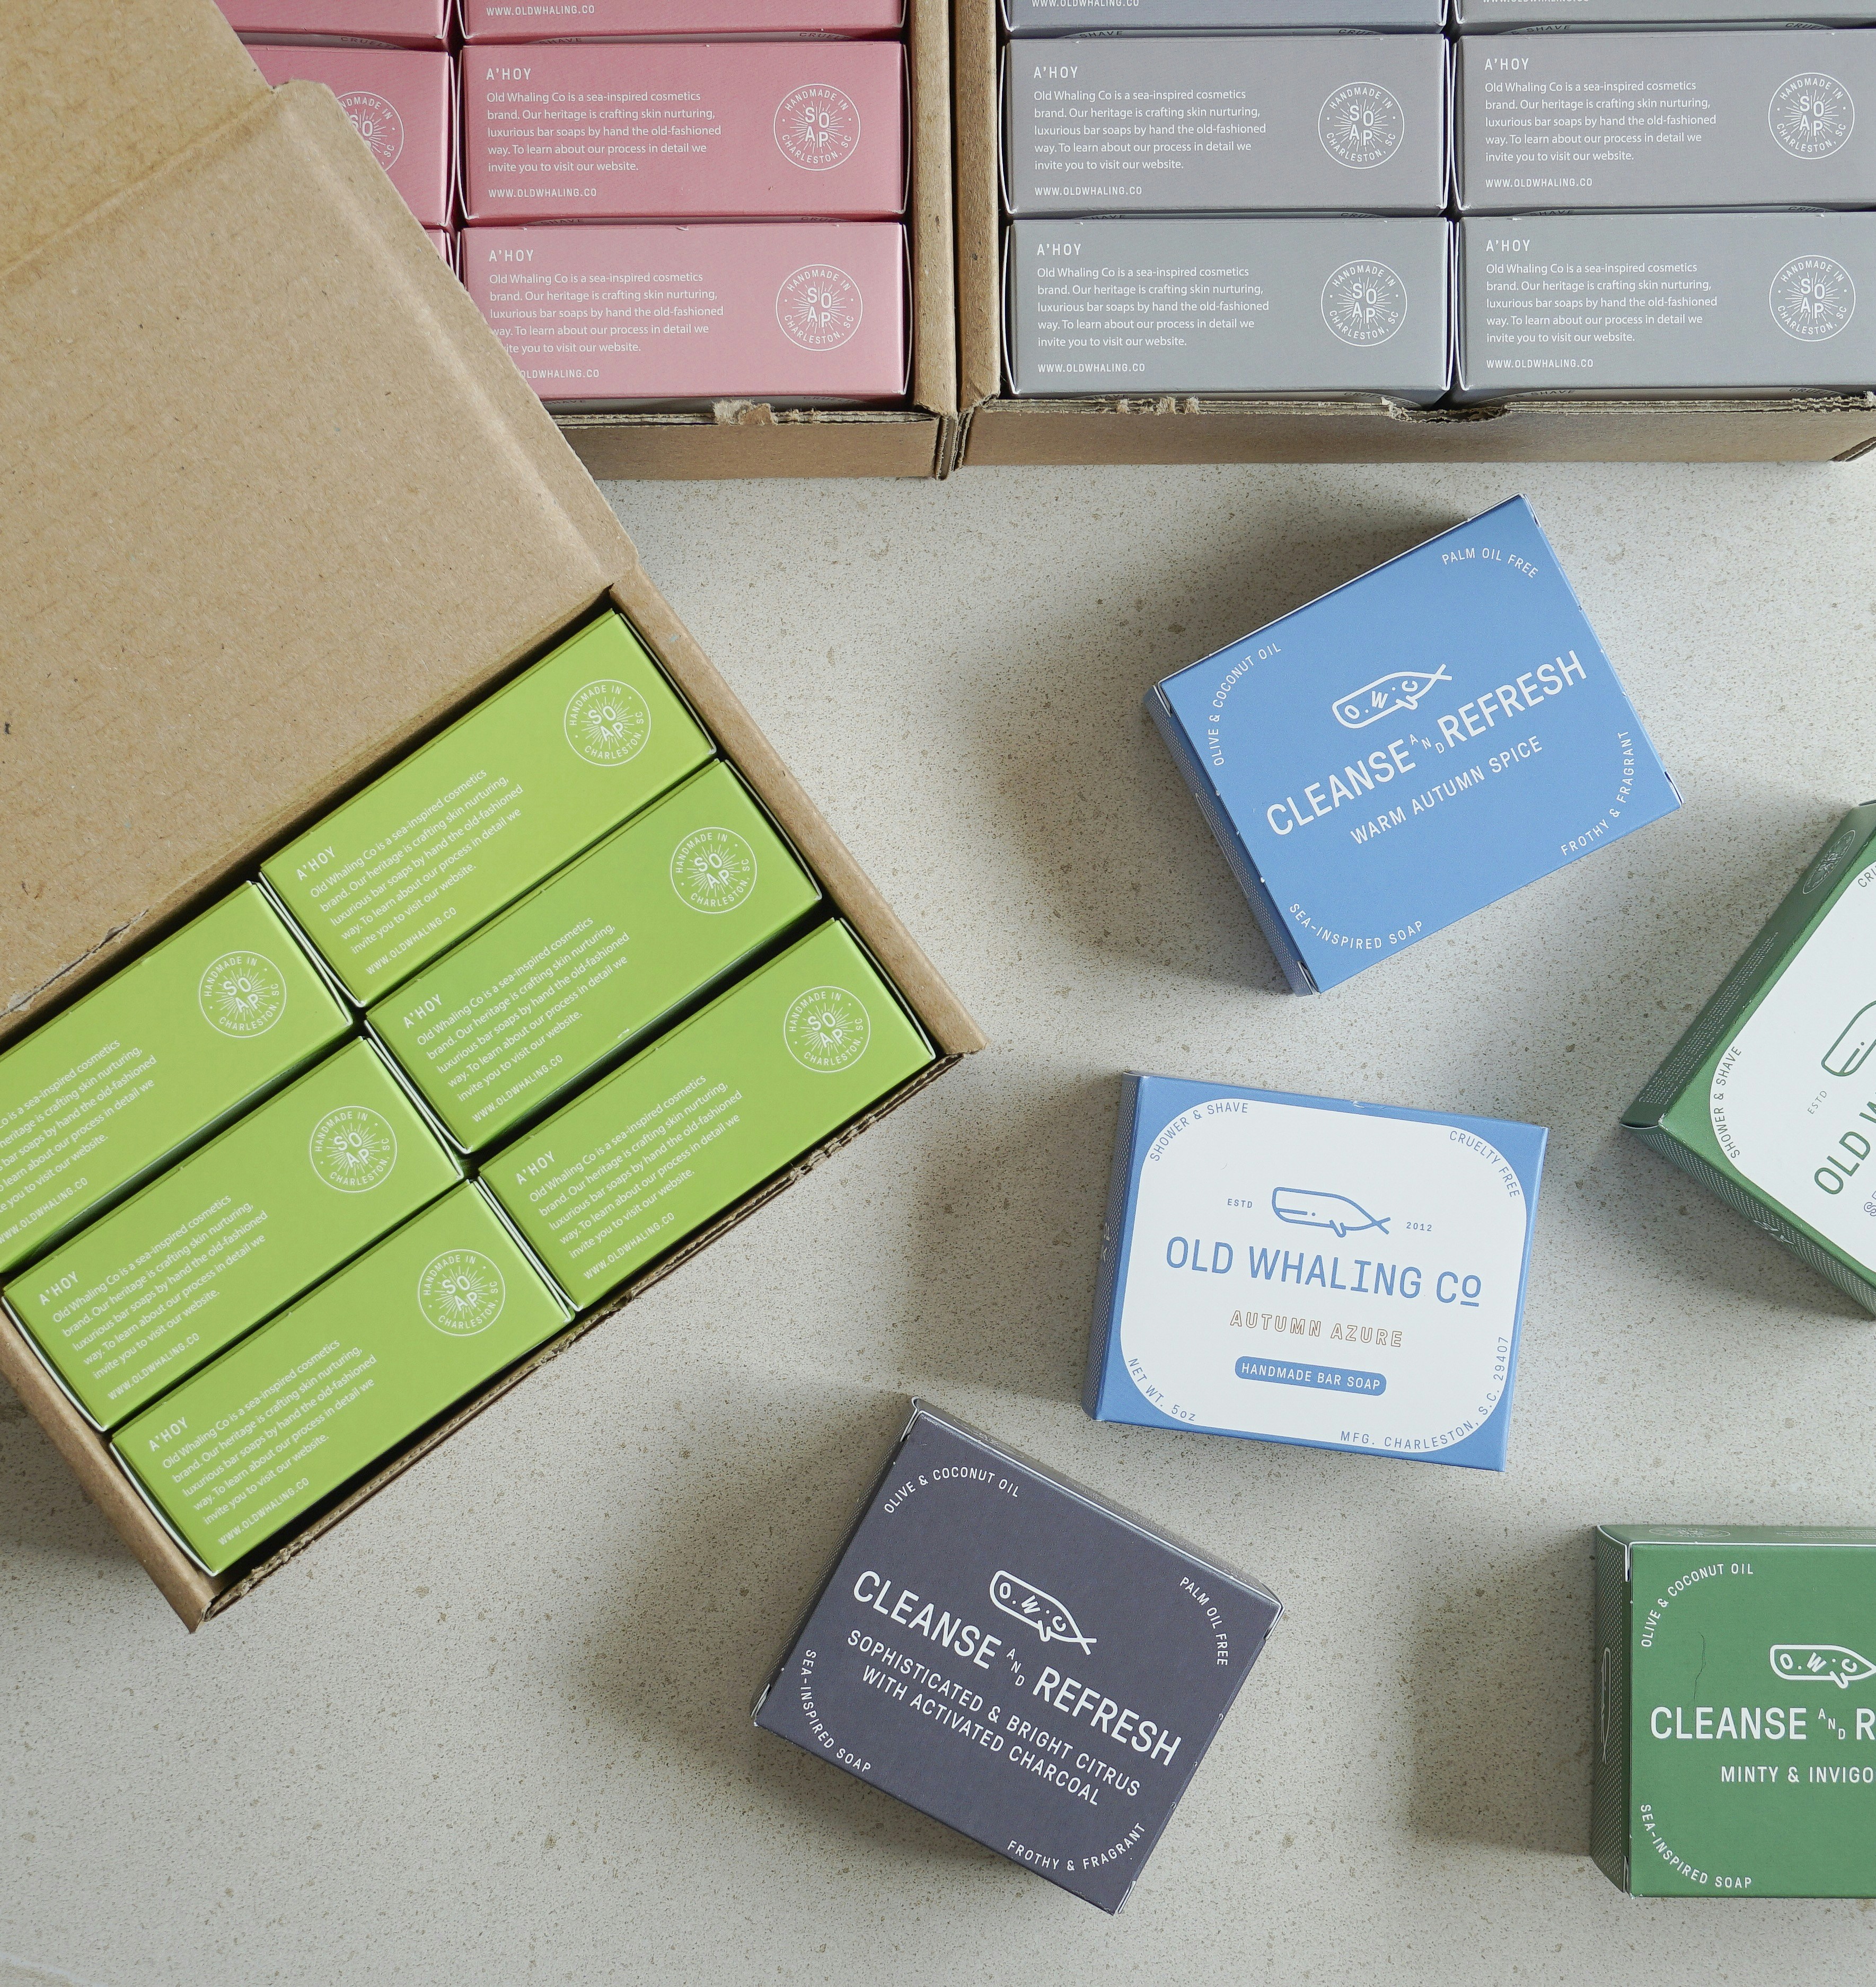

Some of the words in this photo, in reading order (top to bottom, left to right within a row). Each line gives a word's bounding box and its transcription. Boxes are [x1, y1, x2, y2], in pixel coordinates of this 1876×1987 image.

[486, 5, 595, 16] WWW.OLDWHALING.CO
[488, 127, 535, 137] luxurious
[537, 126, 554, 137] bar
[556, 129, 585, 139] soaps
[588, 126, 601, 138] by
[603, 126, 629, 136] hand
[631, 126, 649, 136] the
[651, 125, 721, 136] old-fashioned
[1485, 137, 1508, 147] way.
[1509, 134, 1522, 144] To
[1524, 134, 1549, 144] learn
[1552, 133, 1582, 144] about
[1604, 135, 1642, 145] process
[1644, 133, 1653, 143] in
[1656, 132, 1684, 142] detail
[488, 188, 597, 198] WWW.OLDWHALING.CO
[1034, 186, 1142, 196] WWW.OLDWHALING.CO
[1485, 178, 1592, 188] WWW.OLDWHALING.CO
[1037, 267, 1055, 277] Old
[1056, 267, 1099, 279] Whaling
[1117, 267, 1125, 277] is
[1136, 267, 1196, 279] sea-inspired
[1199, 267, 1249, 277] cosmetics
[1037, 285, 1070, 295] brand.
[1072, 285, 1091, 295] Our
[1094, 284, 1136, 297] heritage
[1139, 284, 1146, 294] is
[1148, 284, 1187, 296] crafting
[1190, 284, 1210, 294] skin
[1332, 265, 1385, 287] HANDMADE
[1385, 275, 1396, 287] IN
[1388, 311, 1398, 324] SC
[1037, 363, 1145, 373] WWW.OLDWHALING.CO
[1486, 359, 1593, 368] WWW.OLDWHALING.CO
[1442, 548, 1475, 564] PALM
[1483, 548, 1501, 561] OIL
[1508, 554, 1538, 578] FREE
[1258, 643, 1281, 659] OIL
[1213, 656, 1254, 708] COCONUT
[1208, 729, 1224, 765] OLIVE
[1267, 739, 1416, 835] CLEANSE
[1410, 734, 1444, 754] AND
[1438, 650, 1587, 747] REFRESH
[1351, 806, 1406, 844] WARM
[1412, 766, 1484, 815] AUTUMN
[1489, 736, 1542, 772] SPICE
[1561, 819, 1609, 855] FROTHY
[1609, 809, 1620, 817] &
[1616, 732, 1634, 803] FRAGRANT
[365, 907, 457, 975] WWW.OLDWHALING.CO
[1290, 904, 1381, 949] SEA-INSPIRED
[1389, 921, 1422, 944] SOAP
[472, 1055, 563, 1122] WWW.OLDWHALING.CO
[1716, 1047, 1741, 1085] SHAVE
[1807, 1090, 1828, 1115] ESTD
[1150, 1117, 1190, 1161] SHOWER
[1193, 1110, 1202, 1119] &
[1208, 1102, 1248, 1114] SHAVE
[1714, 1108, 1740, 1158] SHOWER
[1450, 1131, 1500, 1164] CRUELTY
[1499, 1167, 1520, 1197] FREE
[1813, 1131, 1871, 1195] OLD
[568, 1238, 596, 1259] invite
[594, 1225, 613, 1243] you
[611, 1218, 623, 1229] to
[622, 1204, 643, 1220] visit
[642, 1193, 658, 1207] our
[657, 1170, 695, 1196] website.
[1228, 1199, 1252, 1208] ESTD
[1406, 1222, 1431, 1231] 2012
[583, 1212, 675, 1279] WWW.OLDWHALING.CO
[1167, 1237, 1233, 1274] OLD
[1249, 1246, 1421, 1298] WHALING
[1230, 1310, 1321, 1337] AUTUMN
[1331, 1323, 1402, 1347] AZURE
[107, 1333, 199, 1400] WWW.OLDWHALING.CO
[1129, 1358, 1147, 1381] NET
[1146, 1385, 1164, 1407] WT.
[1172, 1405, 1195, 1421] 5oz
[1242, 1363, 1311, 1381] HANDMADE
[1318, 1373, 1341, 1385] BAR
[1347, 1376, 1380, 1390] SOAP
[1341, 1431, 1374, 1444] MFG.
[1493, 1337, 1508, 1381] 29407
[218, 1478, 309, 1545] WWW.OLDWHALING.CO
[885, 1481, 915, 1513] OLIVE
[919, 1476, 928, 1485] &
[933, 1467, 995, 1483] COCONUT
[999, 1479, 1018, 1497] OIL
[1180, 1577, 1209, 1605] PALM
[1207, 1608, 1222, 1629] OIL
[1216, 1633, 1228, 1665] FREE
[1641, 1610, 1660, 1647] OLIVE
[1658, 1599, 1669, 1608] &
[1668, 1564, 1723, 1596] COCONUT
[1731, 1564, 1753, 1574] OIL
[854, 1571, 1001, 1669] CLEANSE
[1007, 1648, 1024, 1686] AND
[1033, 1666, 1181, 1765] REFRESH
[800, 1650, 834, 1748] SEA-INSPIRED
[836, 1748, 870, 1772] SOAP
[848, 1630, 983, 1711] SOPHISTICATED
[988, 1706, 1000, 1723] &
[1007, 1715, 1073, 1759] BRIGHT
[1077, 1753, 1140, 1796] CITRUS
[1651, 1707, 1806, 1739] CLEANSE
[1818, 1708, 1845, 1739] AND
[863, 1665, 908, 1700] WITH
[910, 1694, 1003, 1751] ACTIVATED
[1009, 1746, 1098, 1805] CHARCOAL
[1722, 1767, 1778, 1782] MINTY
[1788, 1767, 1799, 1782] &
[1007, 1840, 1059, 1869] FROTHY
[1067, 1860, 1074, 1870] &
[1083, 1823, 1144, 1869] FRAGRANT
[1641, 1805, 1707, 1883] SEA-INSPIRED
[1715, 1876, 1751, 1888] SOAP
